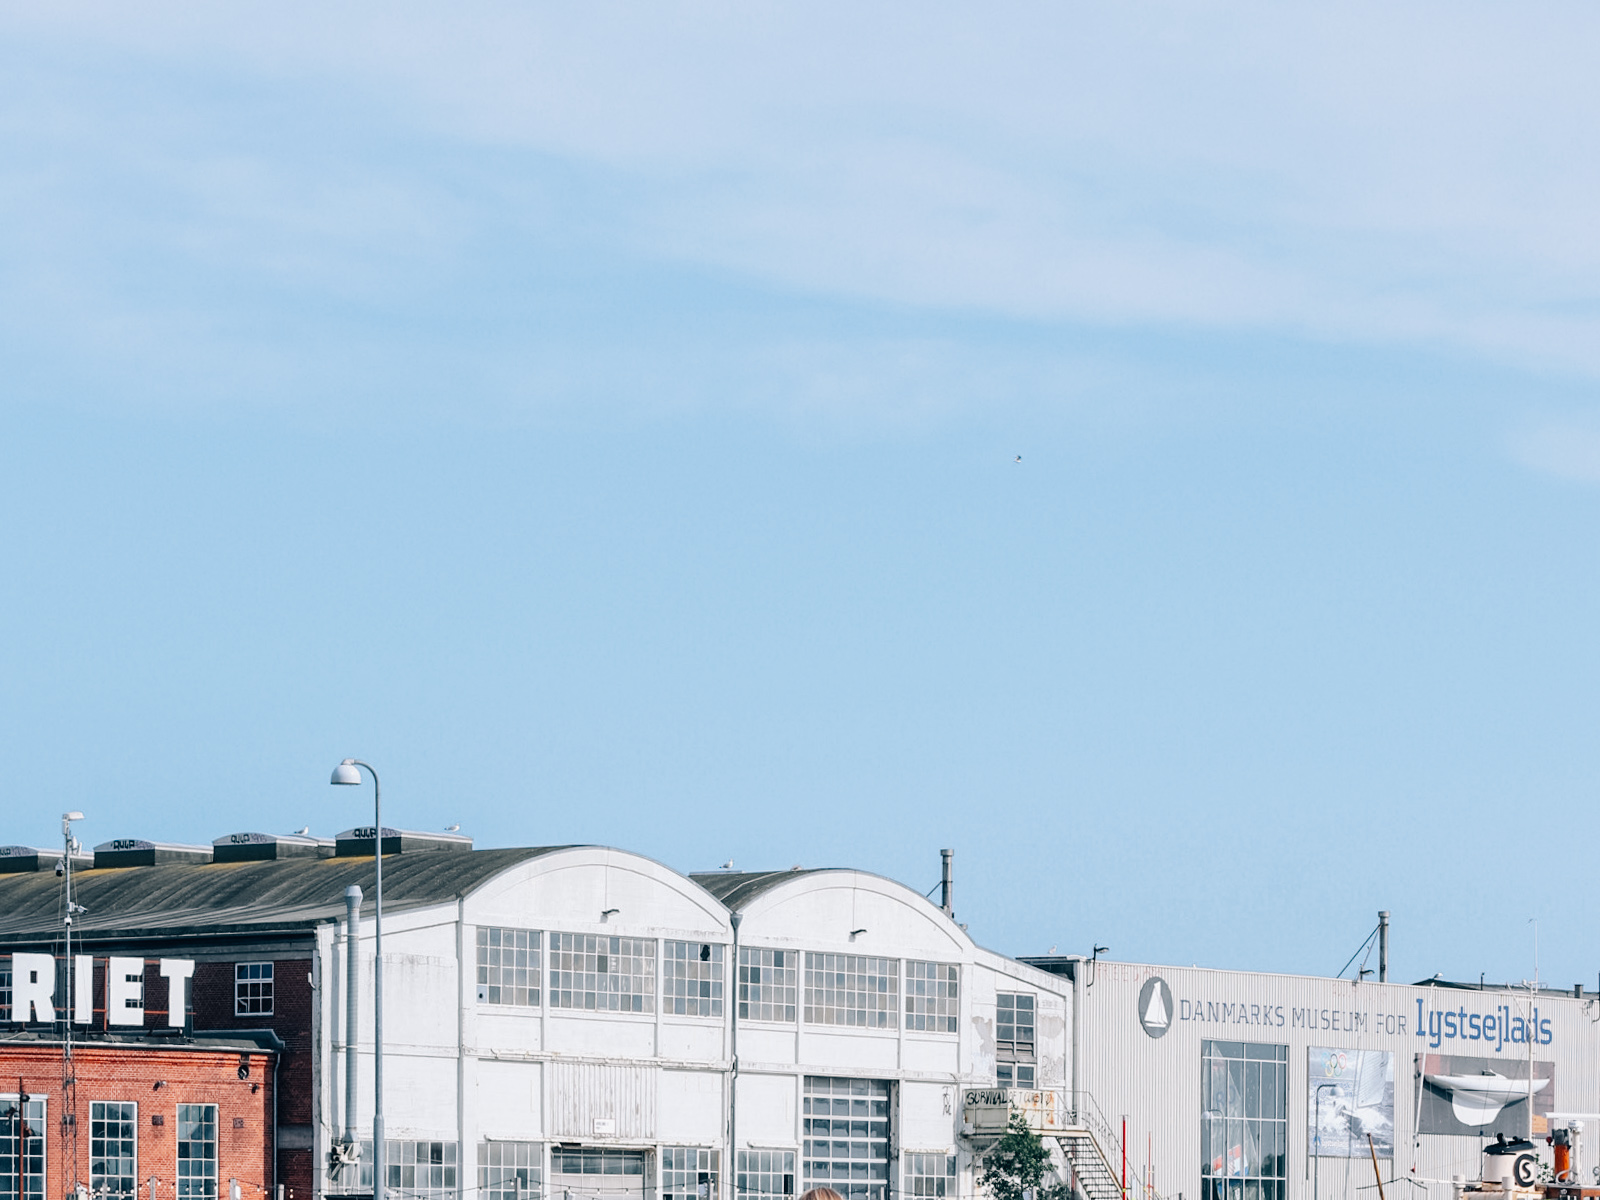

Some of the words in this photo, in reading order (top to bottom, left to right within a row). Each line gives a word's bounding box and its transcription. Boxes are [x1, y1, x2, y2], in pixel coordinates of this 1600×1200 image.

[1179, 999, 1285, 1027] DANMARKS
[1292, 1007, 1368, 1033] MUSEUM
[1376, 1013, 1407, 1036] FOR
